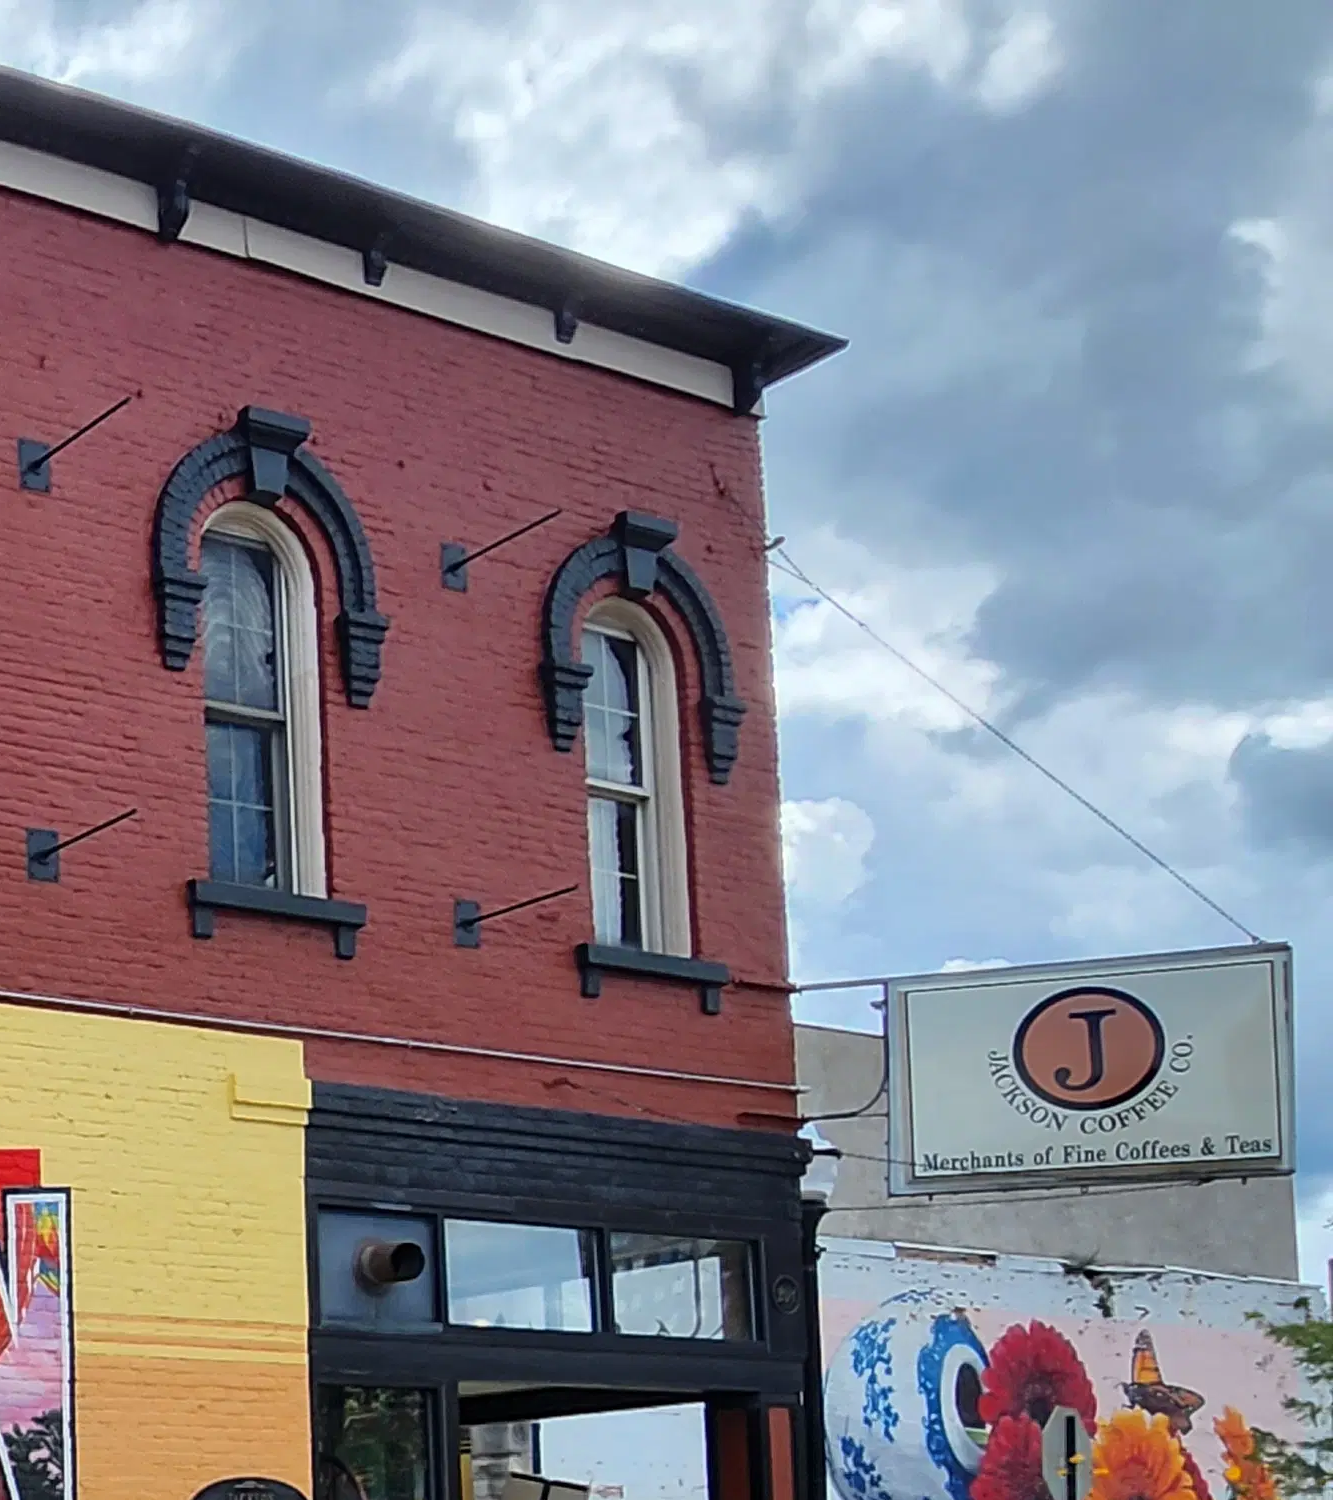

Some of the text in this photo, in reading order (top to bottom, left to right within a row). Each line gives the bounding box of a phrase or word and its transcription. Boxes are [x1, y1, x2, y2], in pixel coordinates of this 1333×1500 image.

[988, 1033, 1194, 1134] JACKSON COFFEE CO.
[1053, 1008, 1117, 1092] J
[922, 1135, 1273, 1172] Merchants of Fine Coffees & Teas
